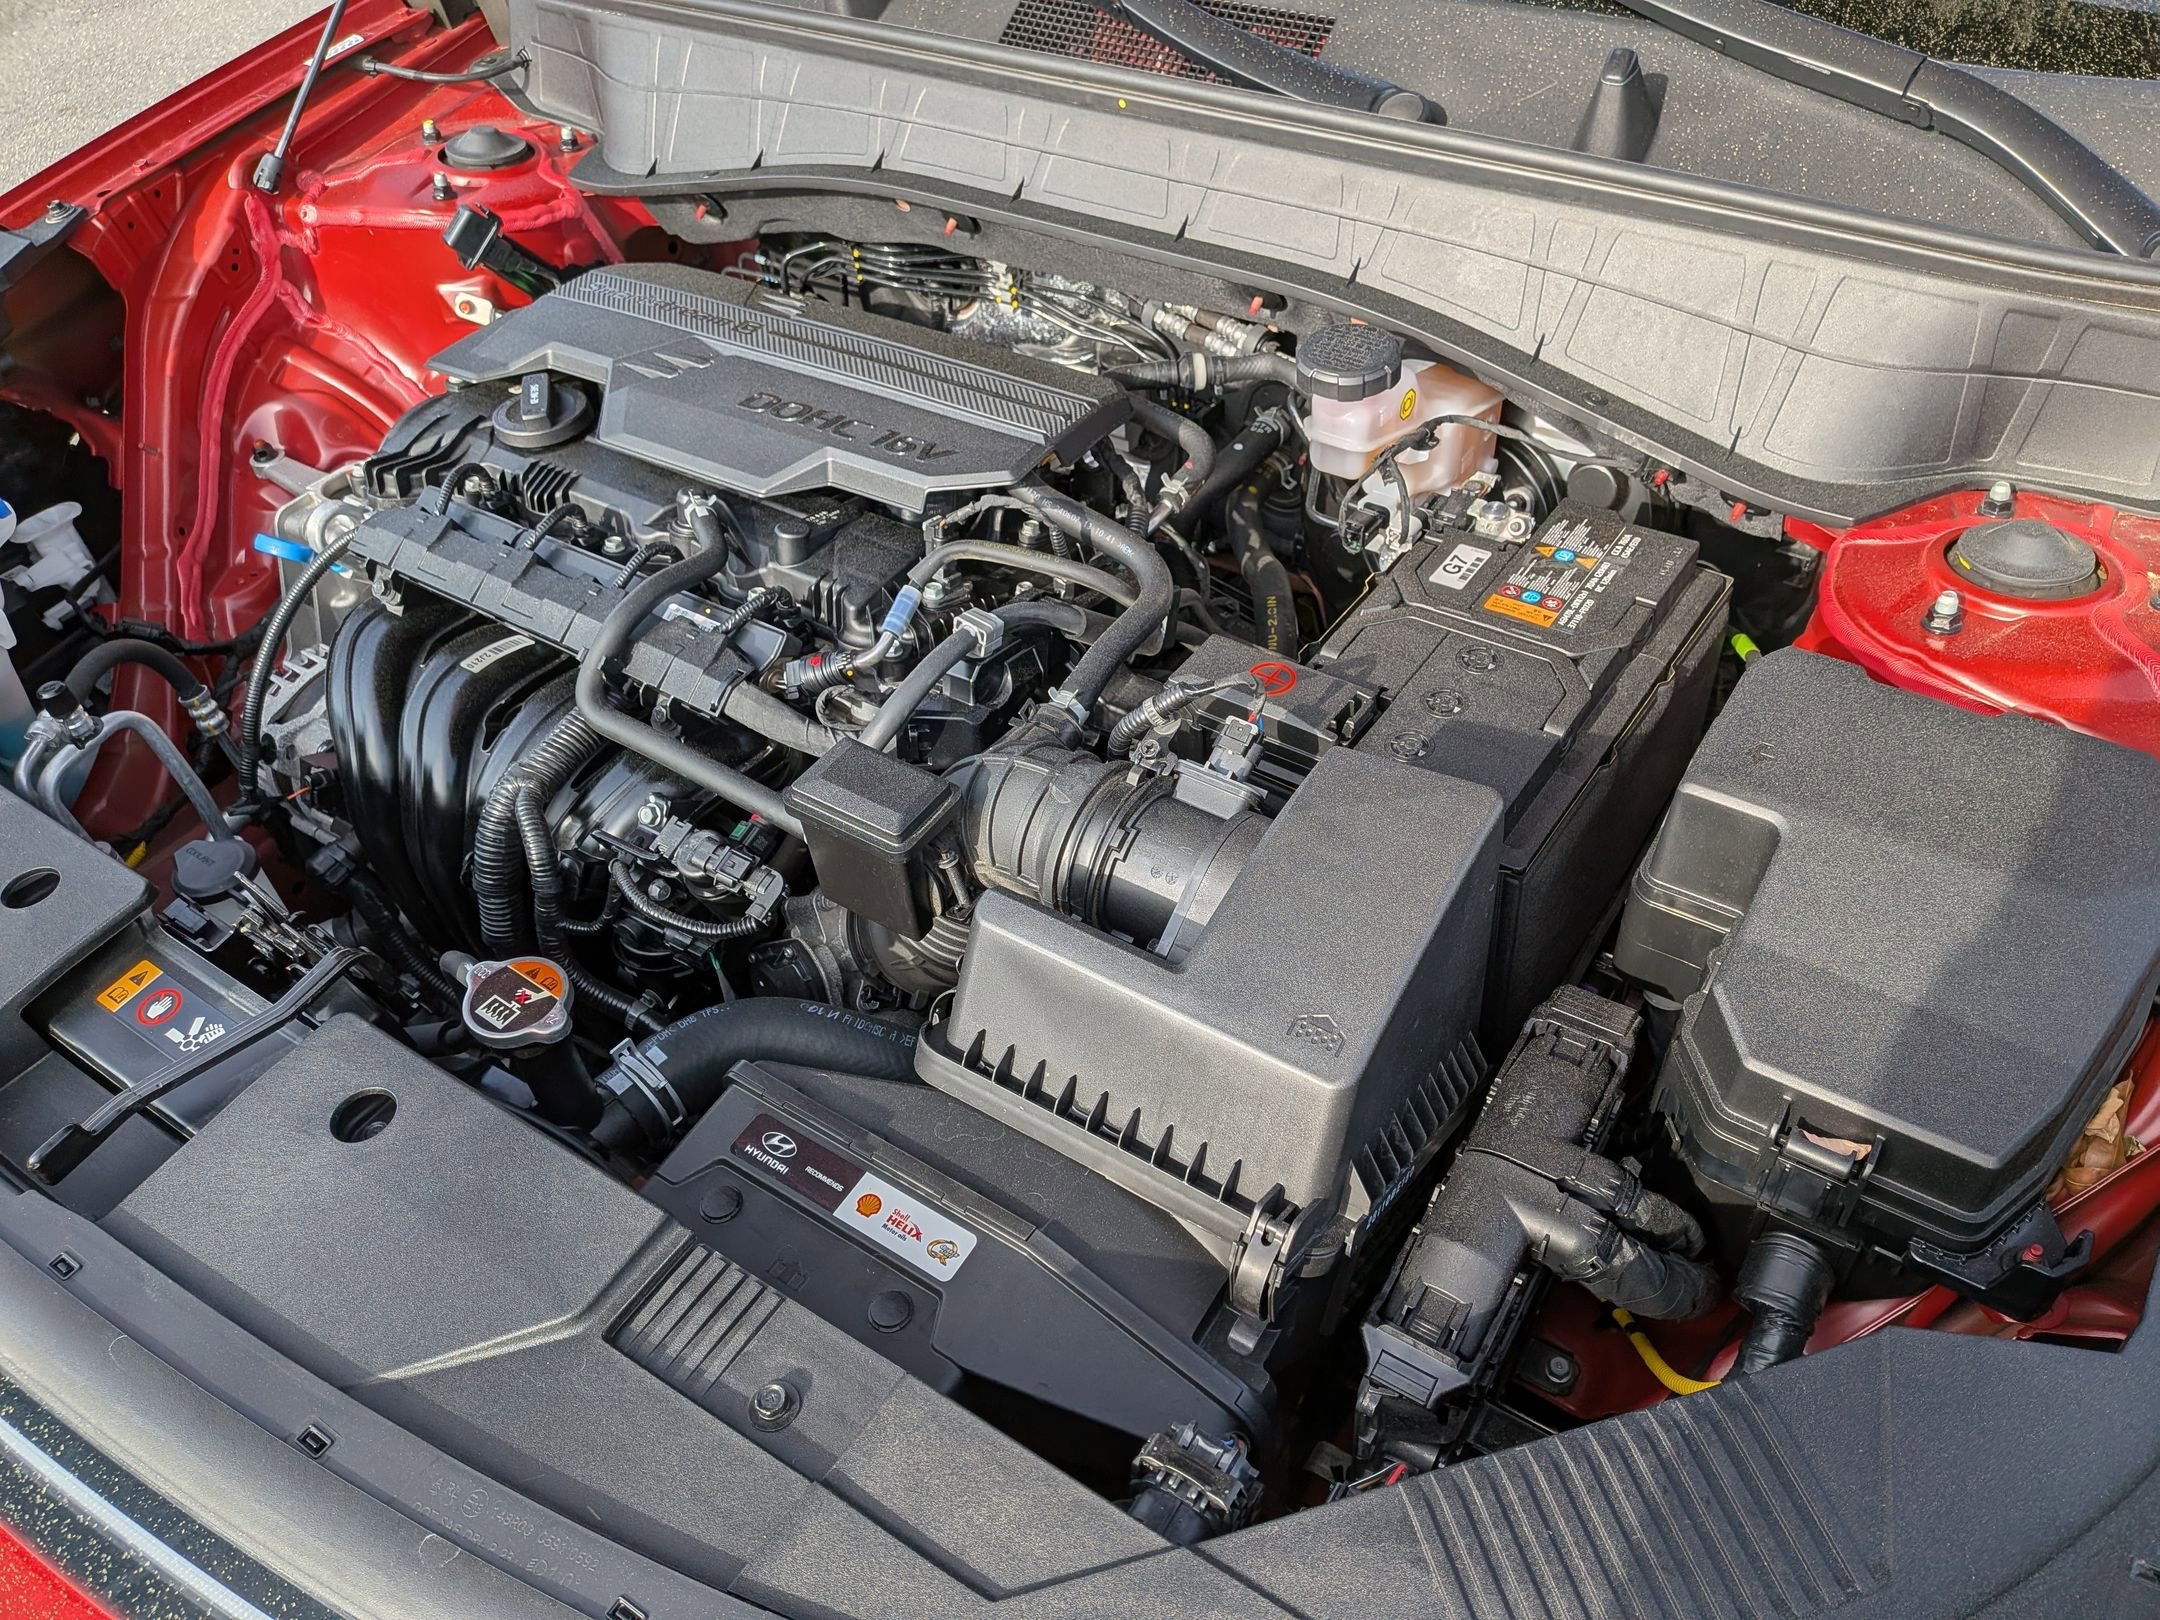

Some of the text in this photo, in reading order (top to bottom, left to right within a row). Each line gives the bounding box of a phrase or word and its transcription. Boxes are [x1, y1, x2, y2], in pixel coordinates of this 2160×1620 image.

[736, 391, 960, 462] DOHC 16V
[1442, 554, 1468, 575] G7
[745, 1143, 789, 1175] HYUNDAI
[804, 1165, 844, 1192] RECOMMENDS
[891, 1207, 911, 1222] Shell
[881, 1222, 908, 1243] Motor oils
[886, 1215, 923, 1243] HELIX
